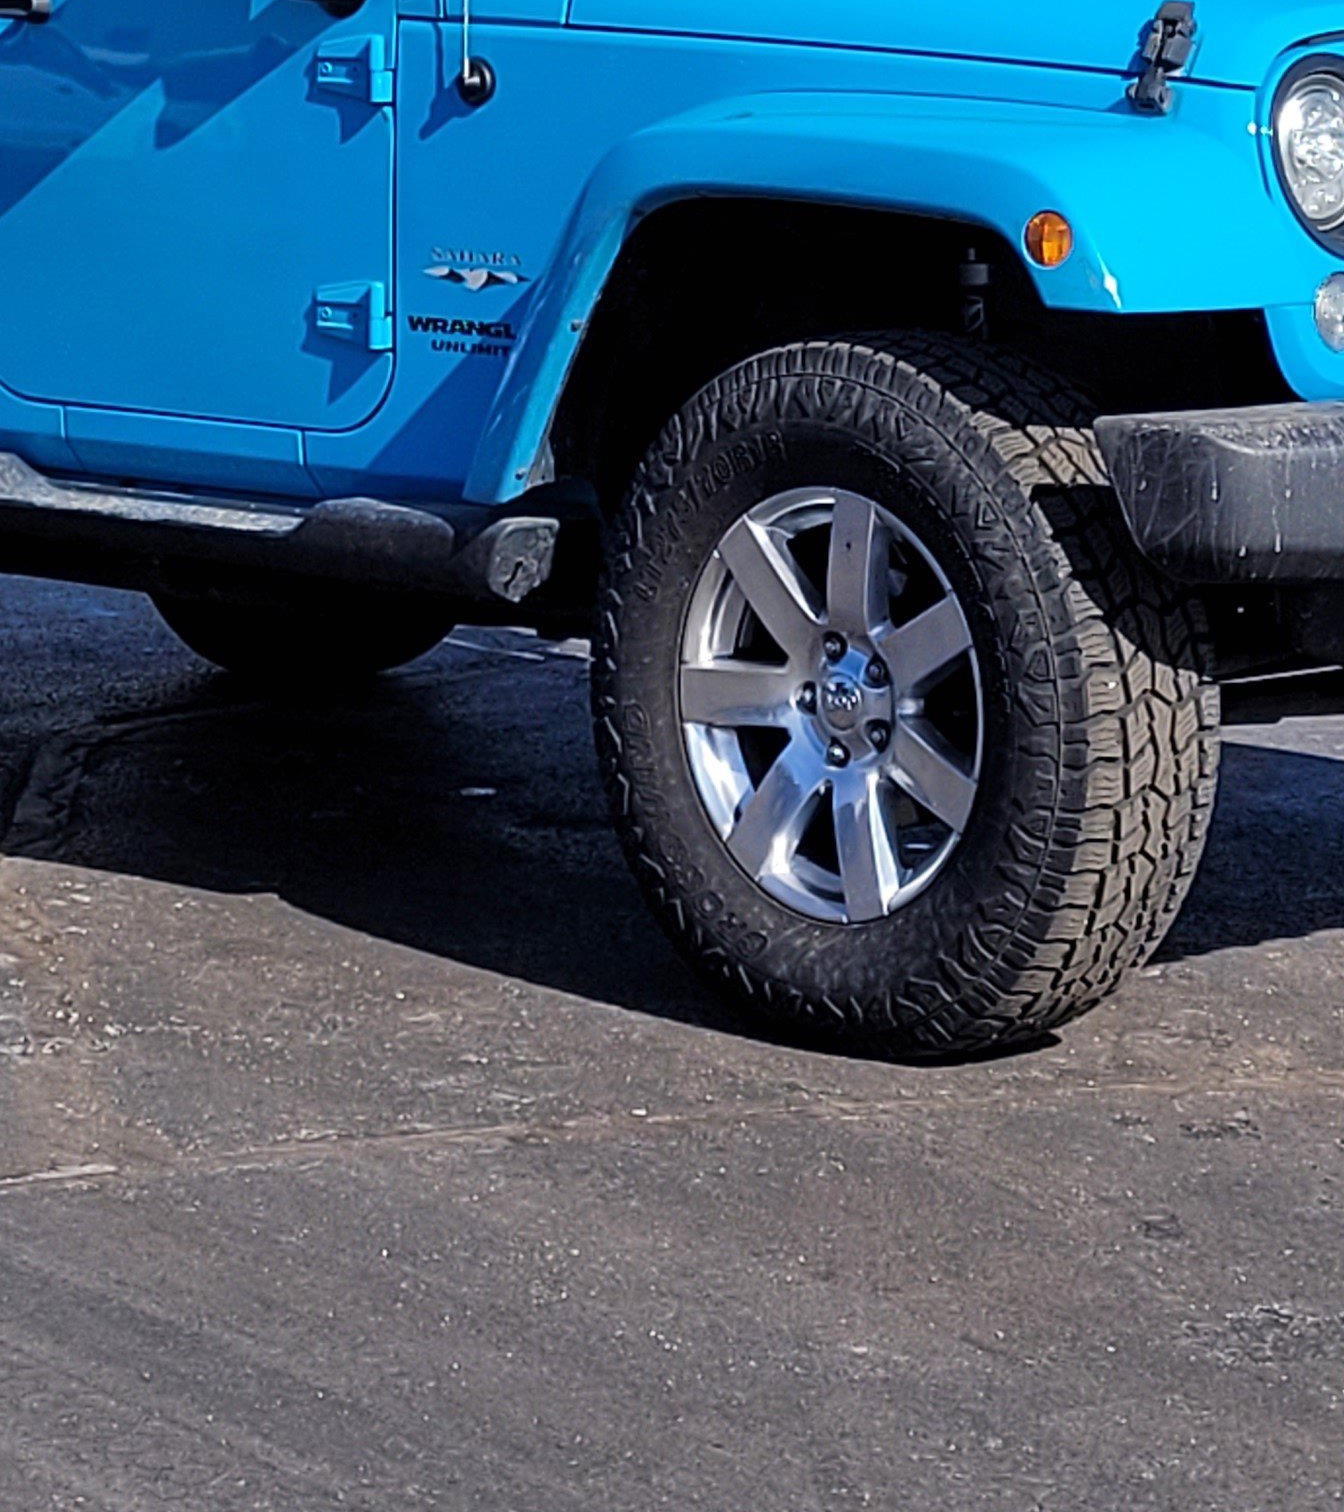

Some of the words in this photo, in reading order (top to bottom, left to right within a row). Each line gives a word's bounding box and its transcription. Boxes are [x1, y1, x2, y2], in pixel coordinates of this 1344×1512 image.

[430, 246, 522, 267] SAHARA
[407, 315, 519, 341] WRANGL
[430, 339, 515, 358] UNLIMIT
